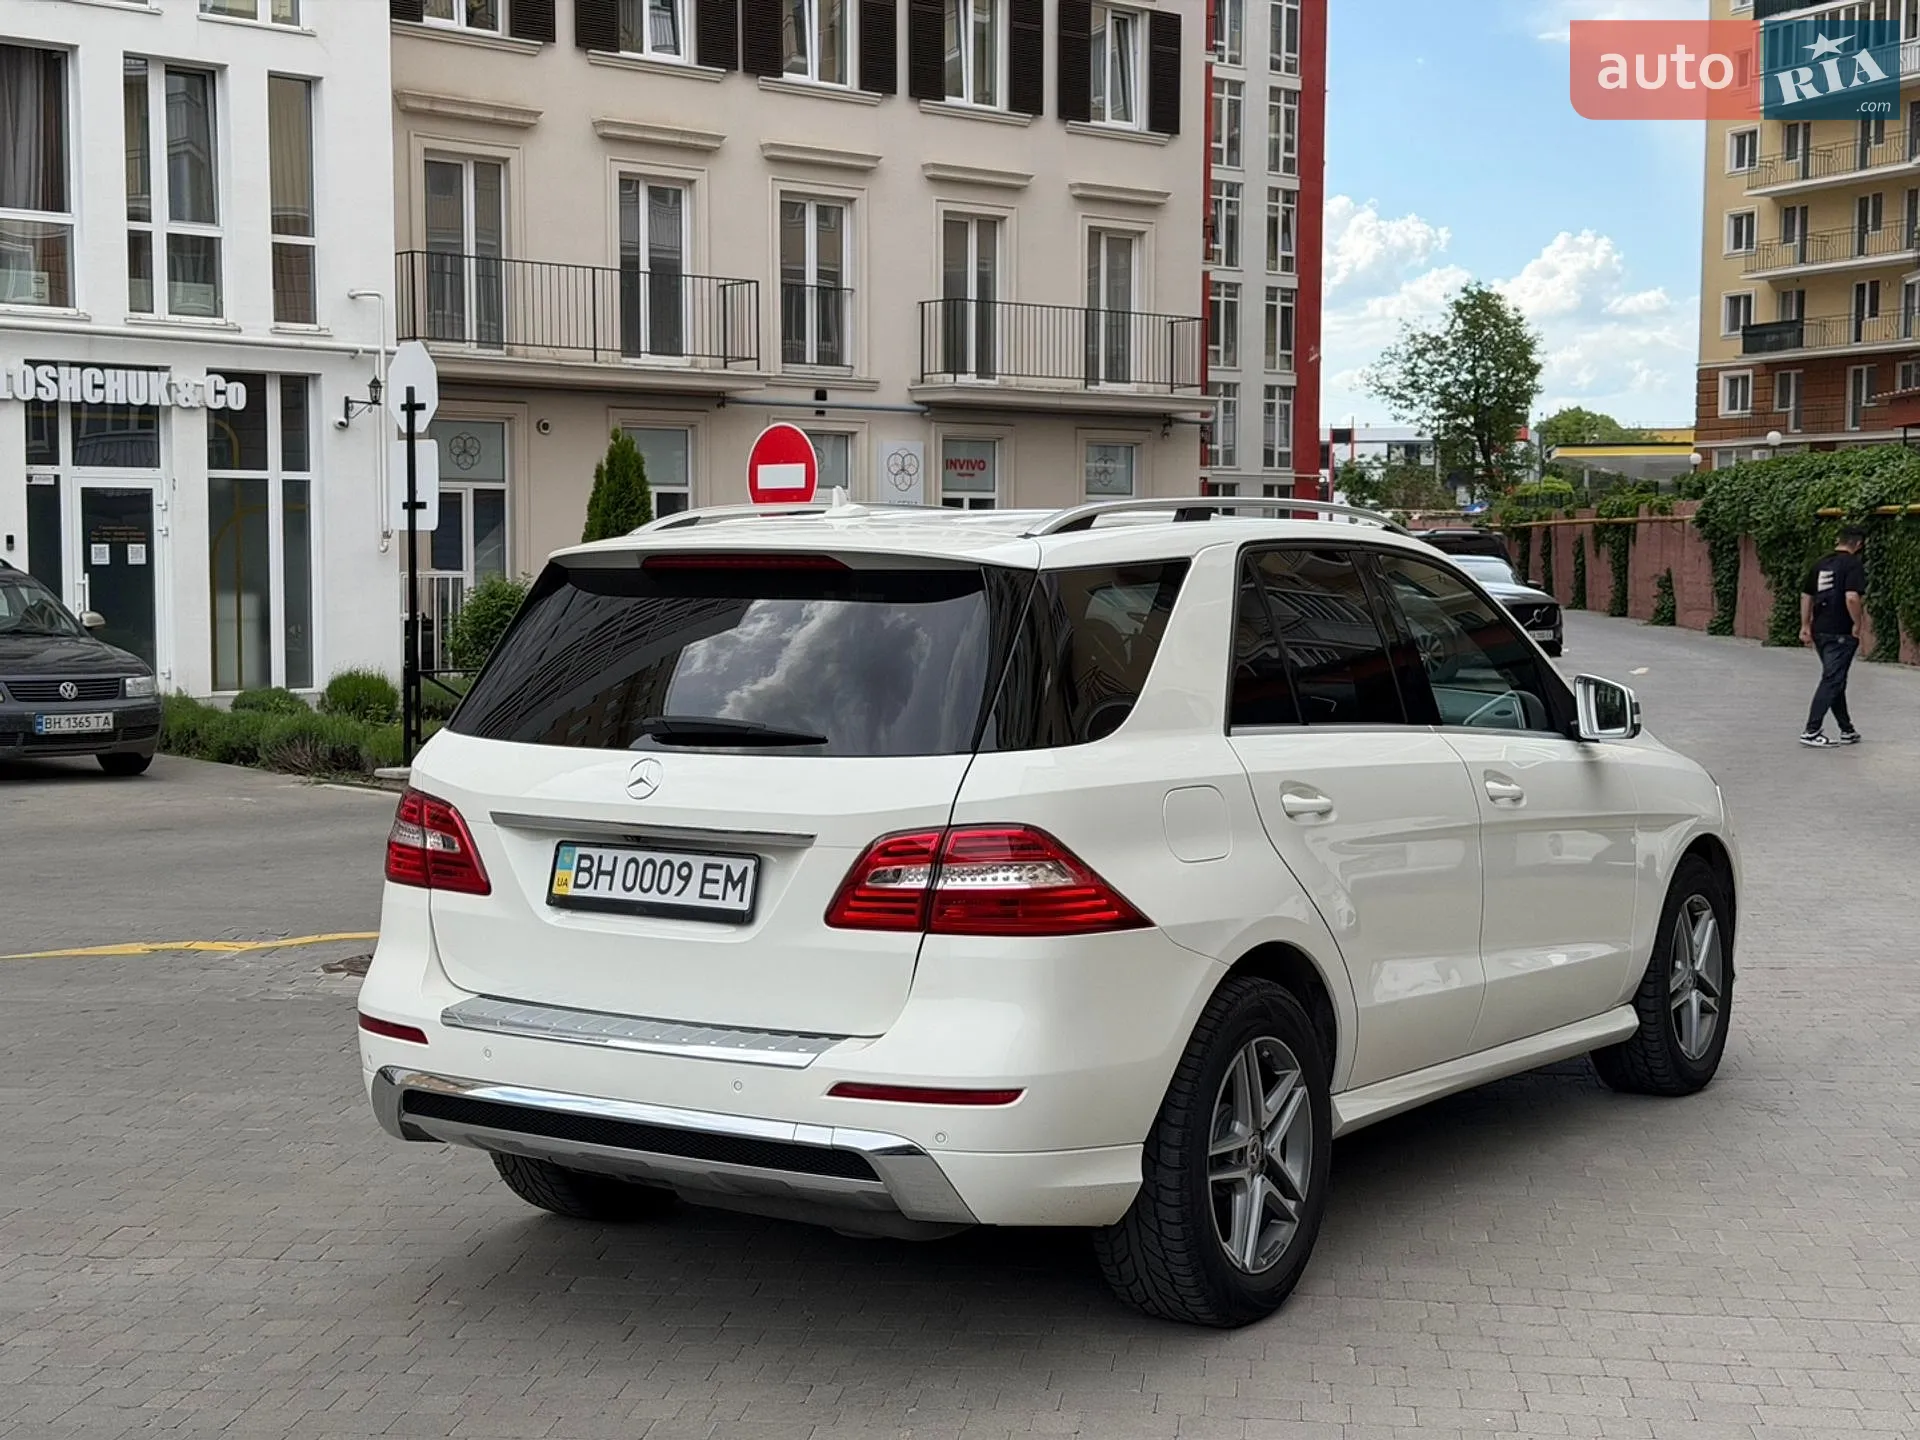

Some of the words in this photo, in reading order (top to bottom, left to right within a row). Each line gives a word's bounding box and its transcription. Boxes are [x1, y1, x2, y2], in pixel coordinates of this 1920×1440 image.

[175, 379, 201, 408] &
[204, 373, 247, 411] Co
[945, 458, 986, 472] INVIVO
[45, 717, 61, 729] BH
[65, 716, 91, 729] 1365
[94, 715, 111, 728] TA
[573, 853, 618, 891] BH
[622, 856, 693, 897] 0009
[698, 862, 749, 903] EM
